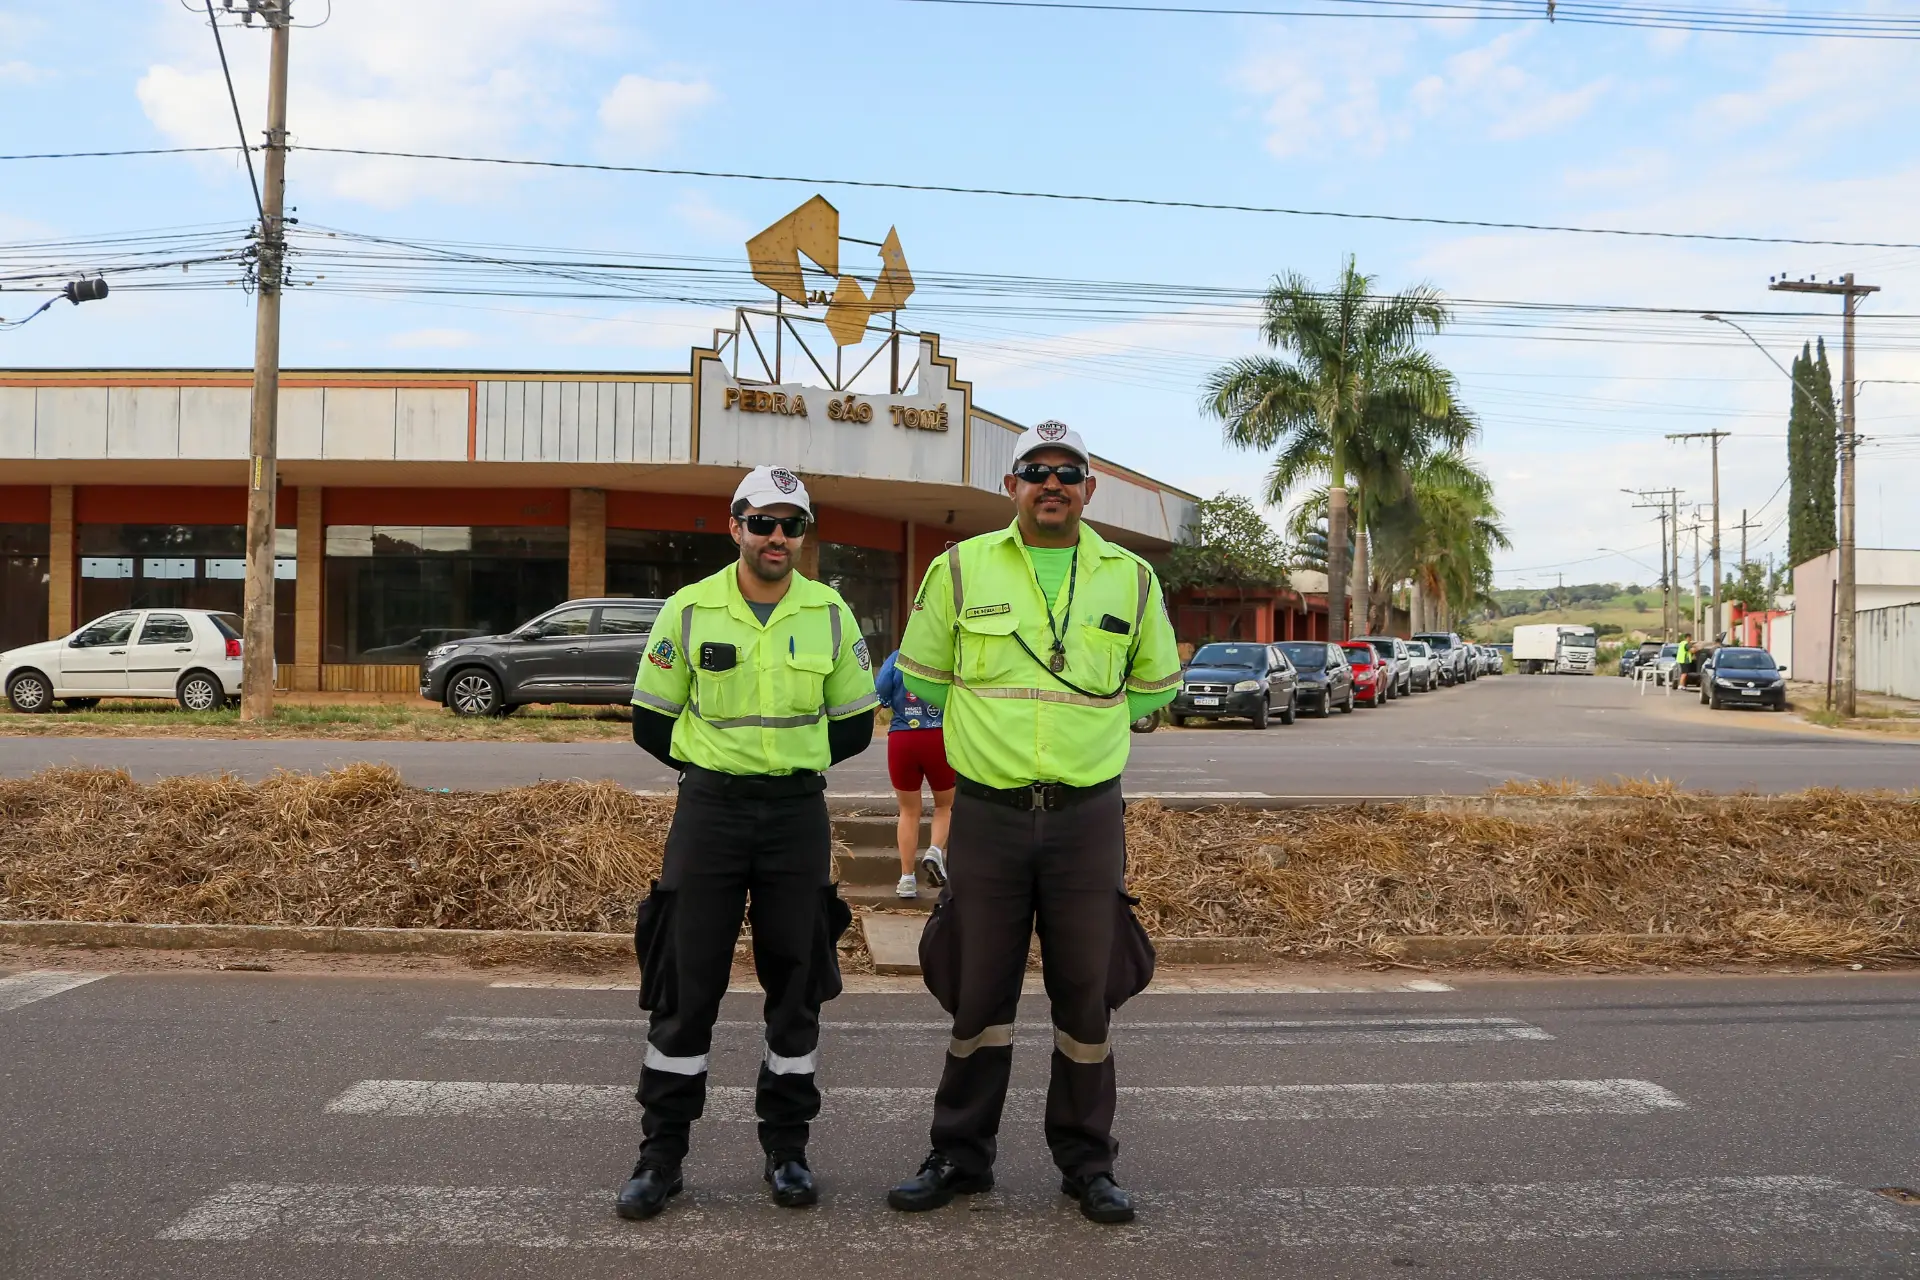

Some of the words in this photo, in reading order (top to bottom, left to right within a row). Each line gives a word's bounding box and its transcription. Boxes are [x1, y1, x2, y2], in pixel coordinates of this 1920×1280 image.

[724, 387, 808, 417] PEDRA
[827, 394, 874, 424] SÃO
[889, 403, 949, 432] TOMÉ
